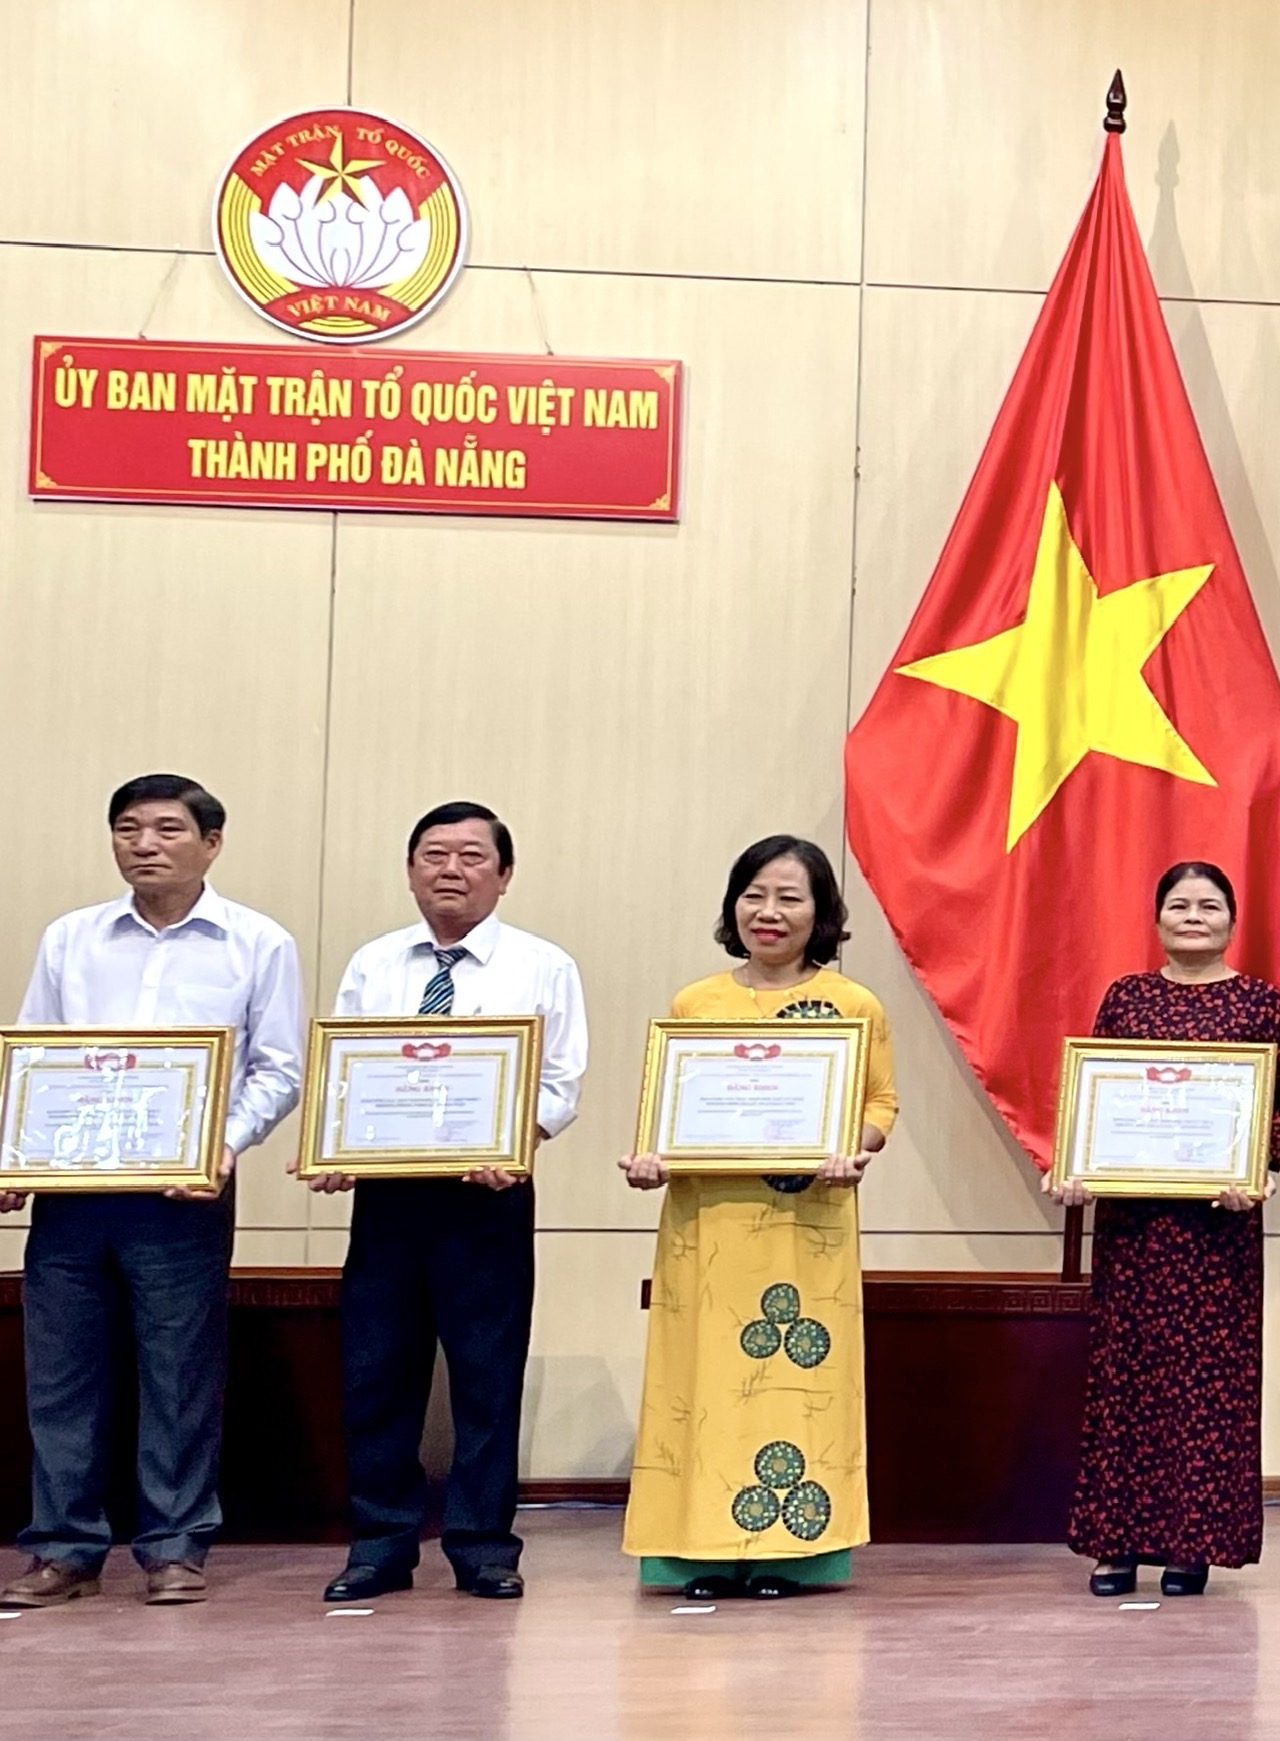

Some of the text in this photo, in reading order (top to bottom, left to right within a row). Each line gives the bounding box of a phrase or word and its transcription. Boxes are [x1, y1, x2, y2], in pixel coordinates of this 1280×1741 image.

[287, 296, 391, 322] VIỆT NAM
[55, 355, 659, 436] ỦY BAN MẶT TRẬN TỔ QUỐC VIỆT NAM
[187, 429, 527, 490] THÀNH PHỐ ĐÀ NẴNG
